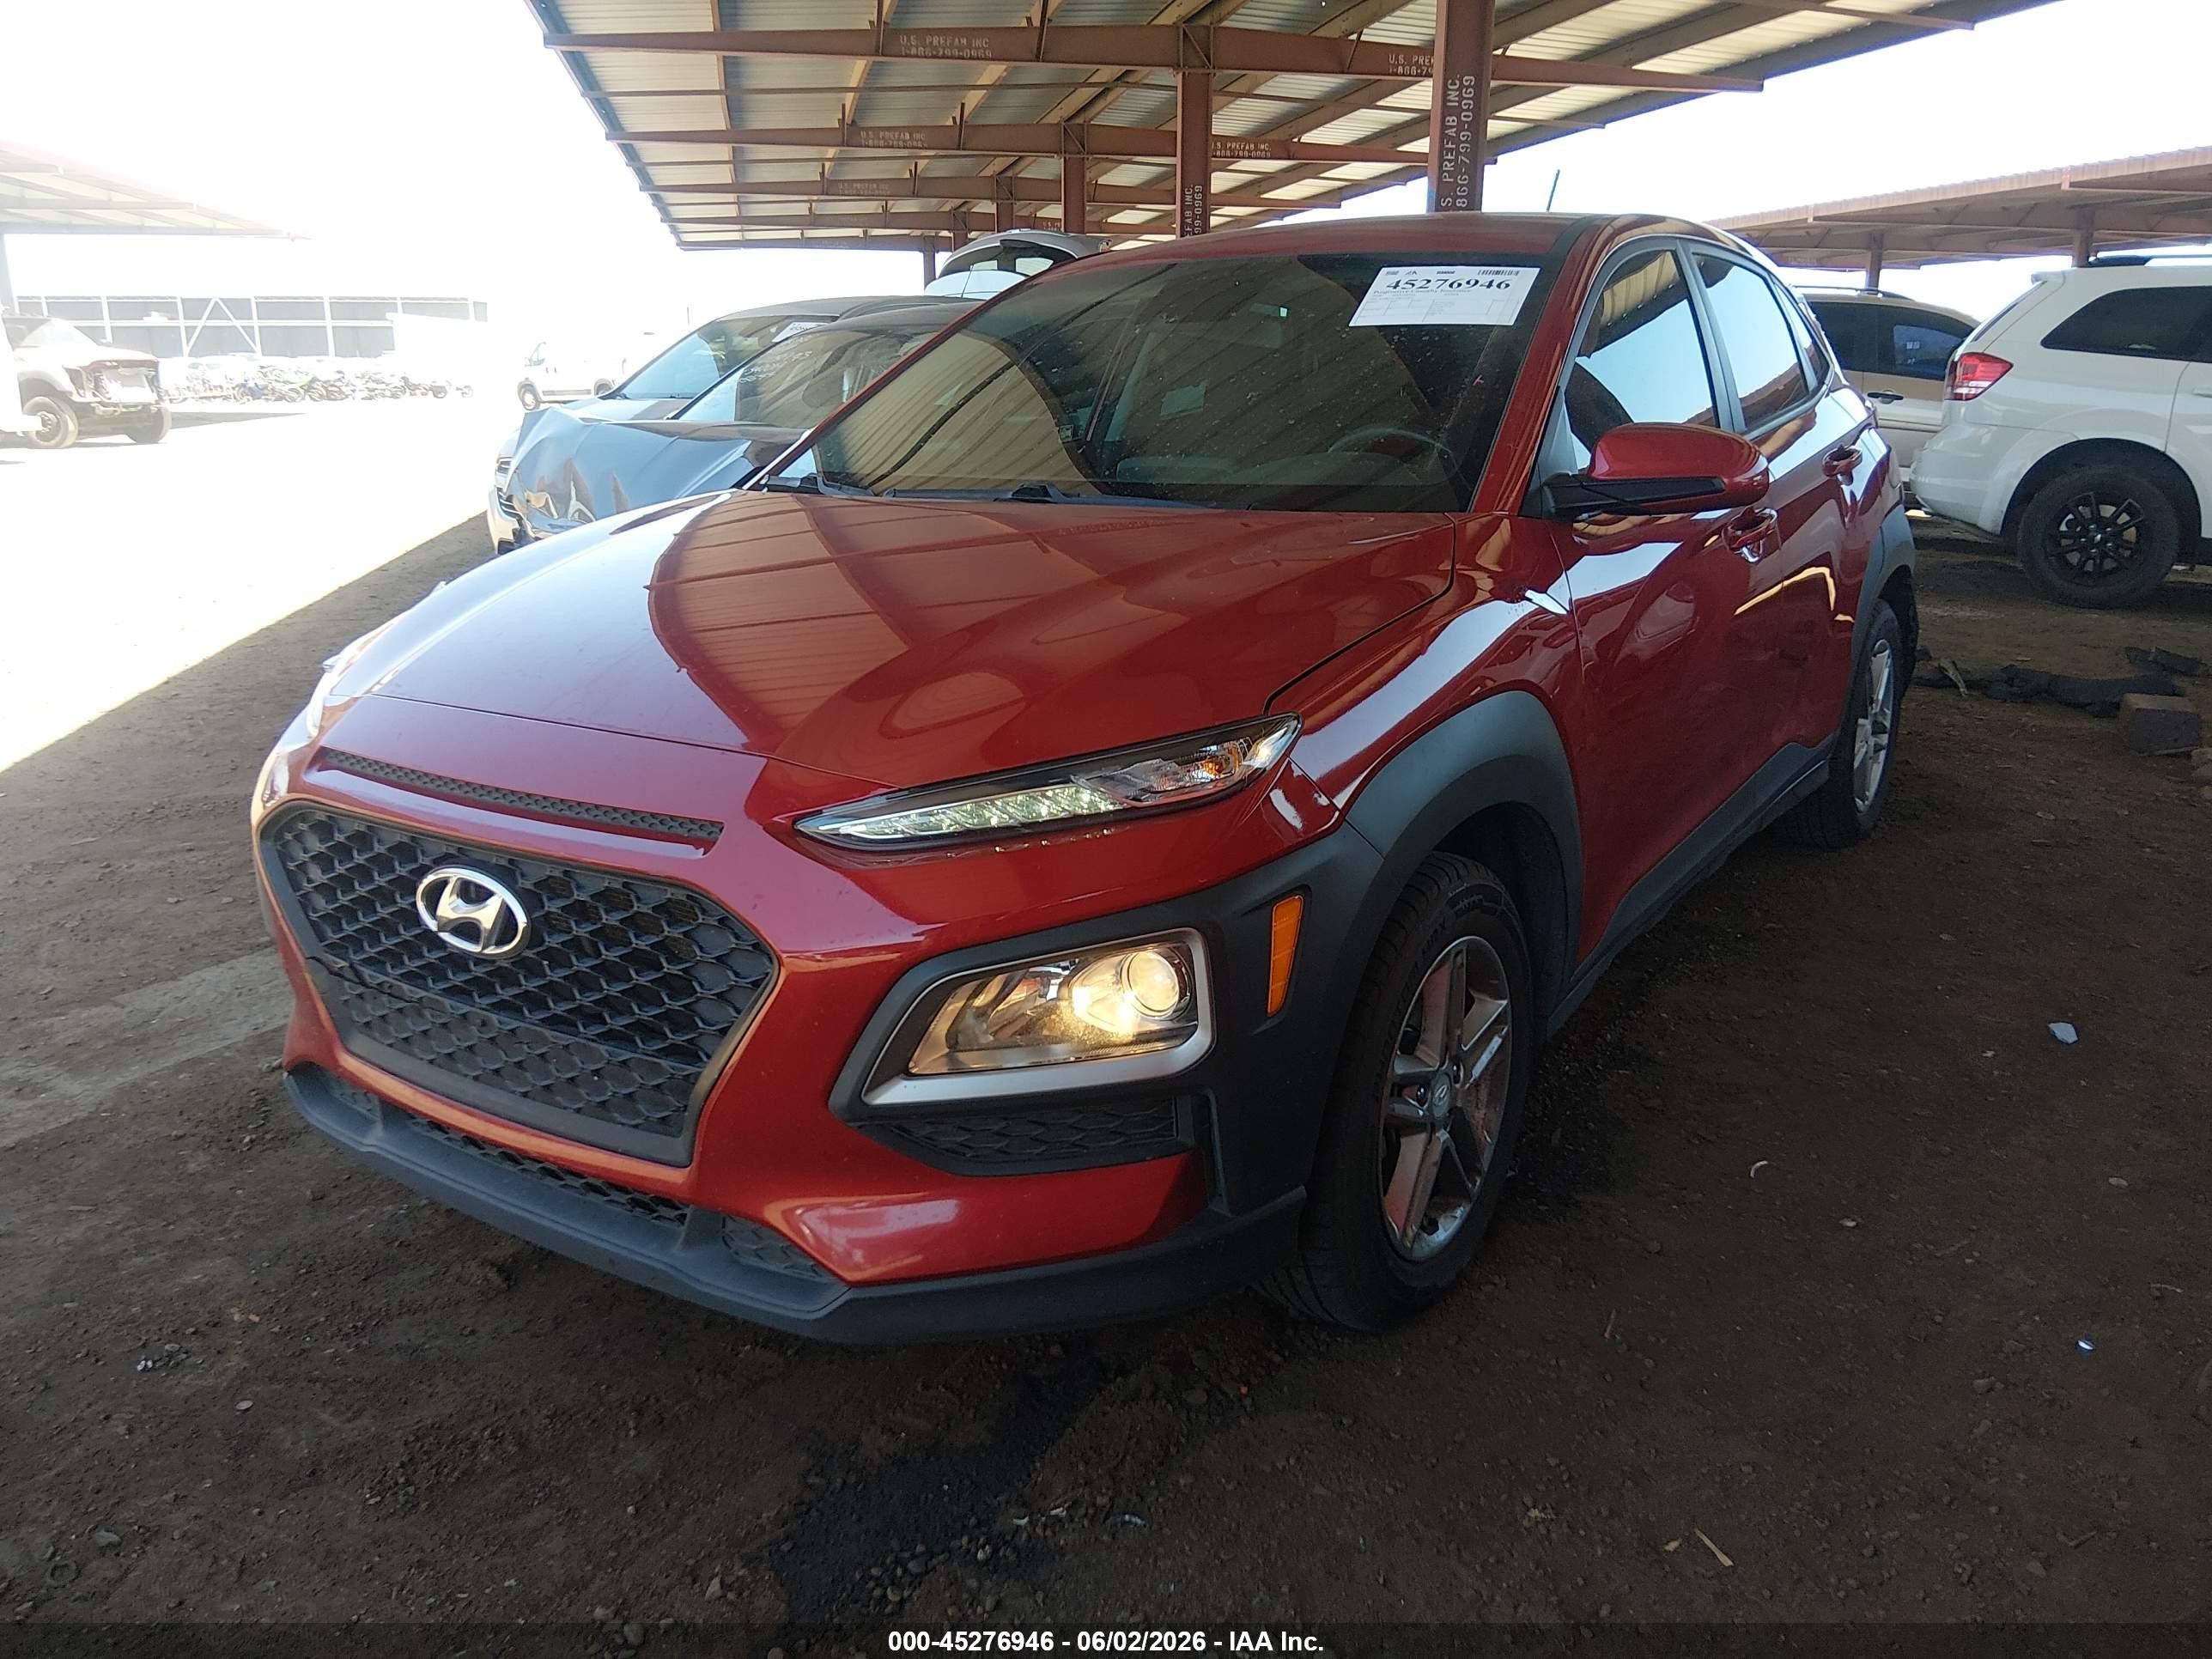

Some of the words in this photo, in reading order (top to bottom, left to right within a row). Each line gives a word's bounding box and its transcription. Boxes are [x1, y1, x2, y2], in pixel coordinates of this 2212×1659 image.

[926, 35, 967, 46] PREFAB
[1389, 54, 1407, 64] U.S.
[1446, 75, 1460, 106] INC.
[1443, 116, 1458, 182] PREFAB
[1455, 76, 1475, 208] 866-799-0969
[1184, 185, 1194, 205] INC.
[1194, 185, 1203, 234] 99-0969
[1184, 210, 1193, 237] EFAB
[1386, 279, 1512, 289] 45276946
